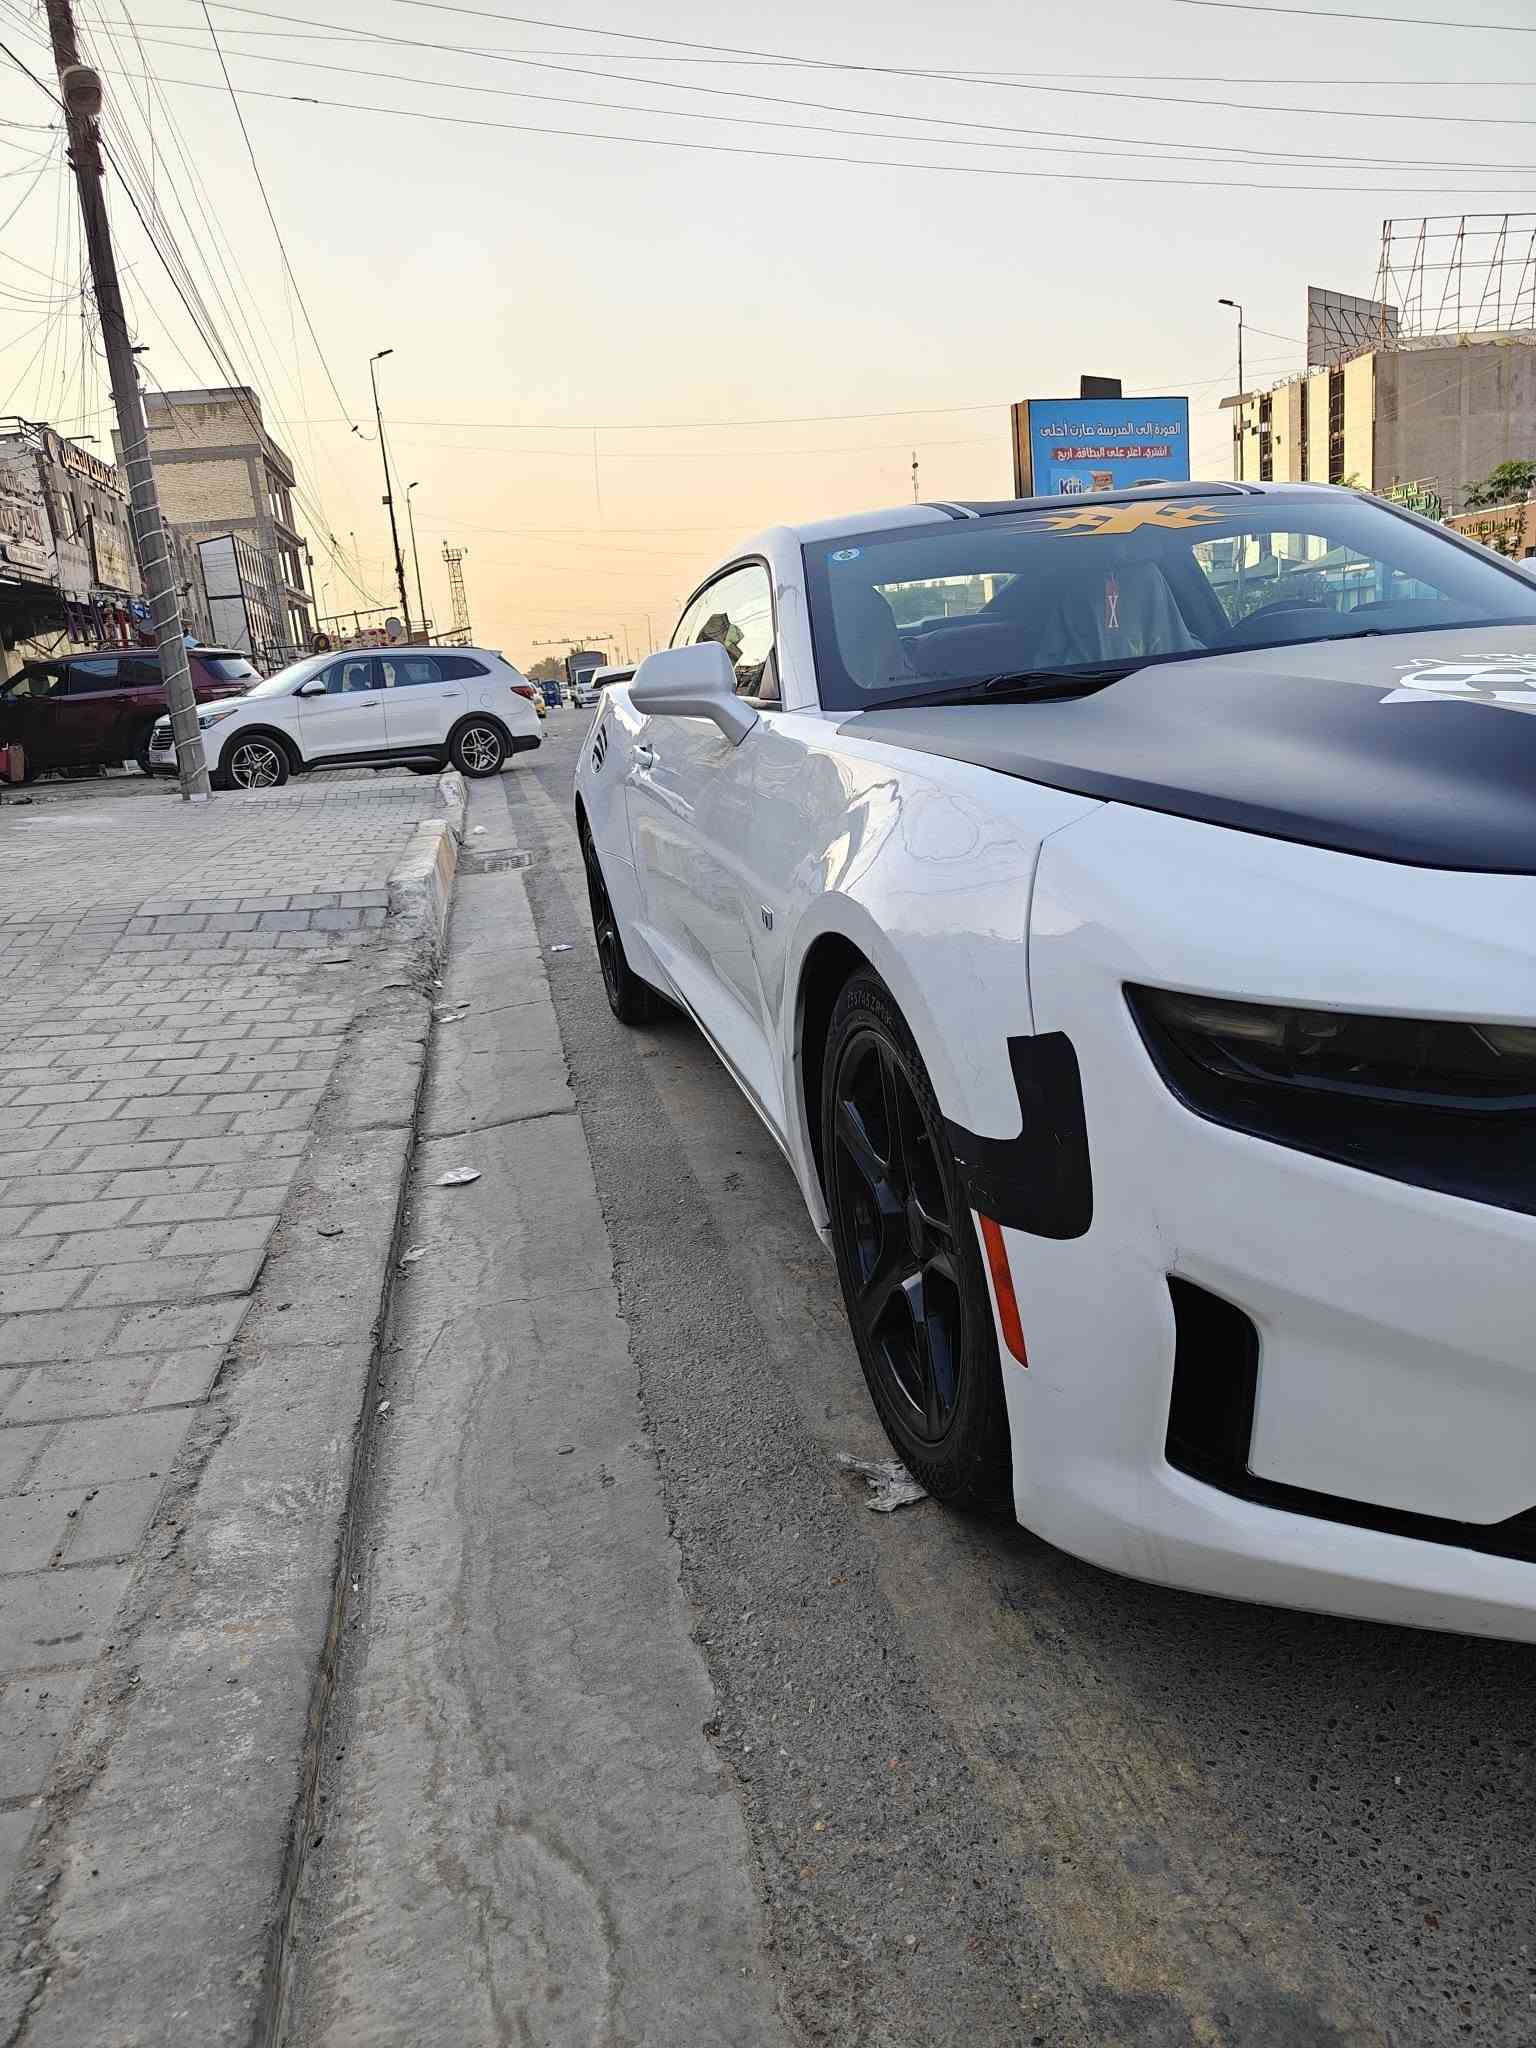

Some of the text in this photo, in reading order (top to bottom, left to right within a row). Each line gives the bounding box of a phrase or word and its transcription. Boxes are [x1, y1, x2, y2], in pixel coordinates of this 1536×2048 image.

[1070, 423, 1095, 437] صارت
[1097, 423, 1133, 437] المدرسة
[1106, 447, 1126, 457] على
[1059, 479, 1082, 495] Kiri
